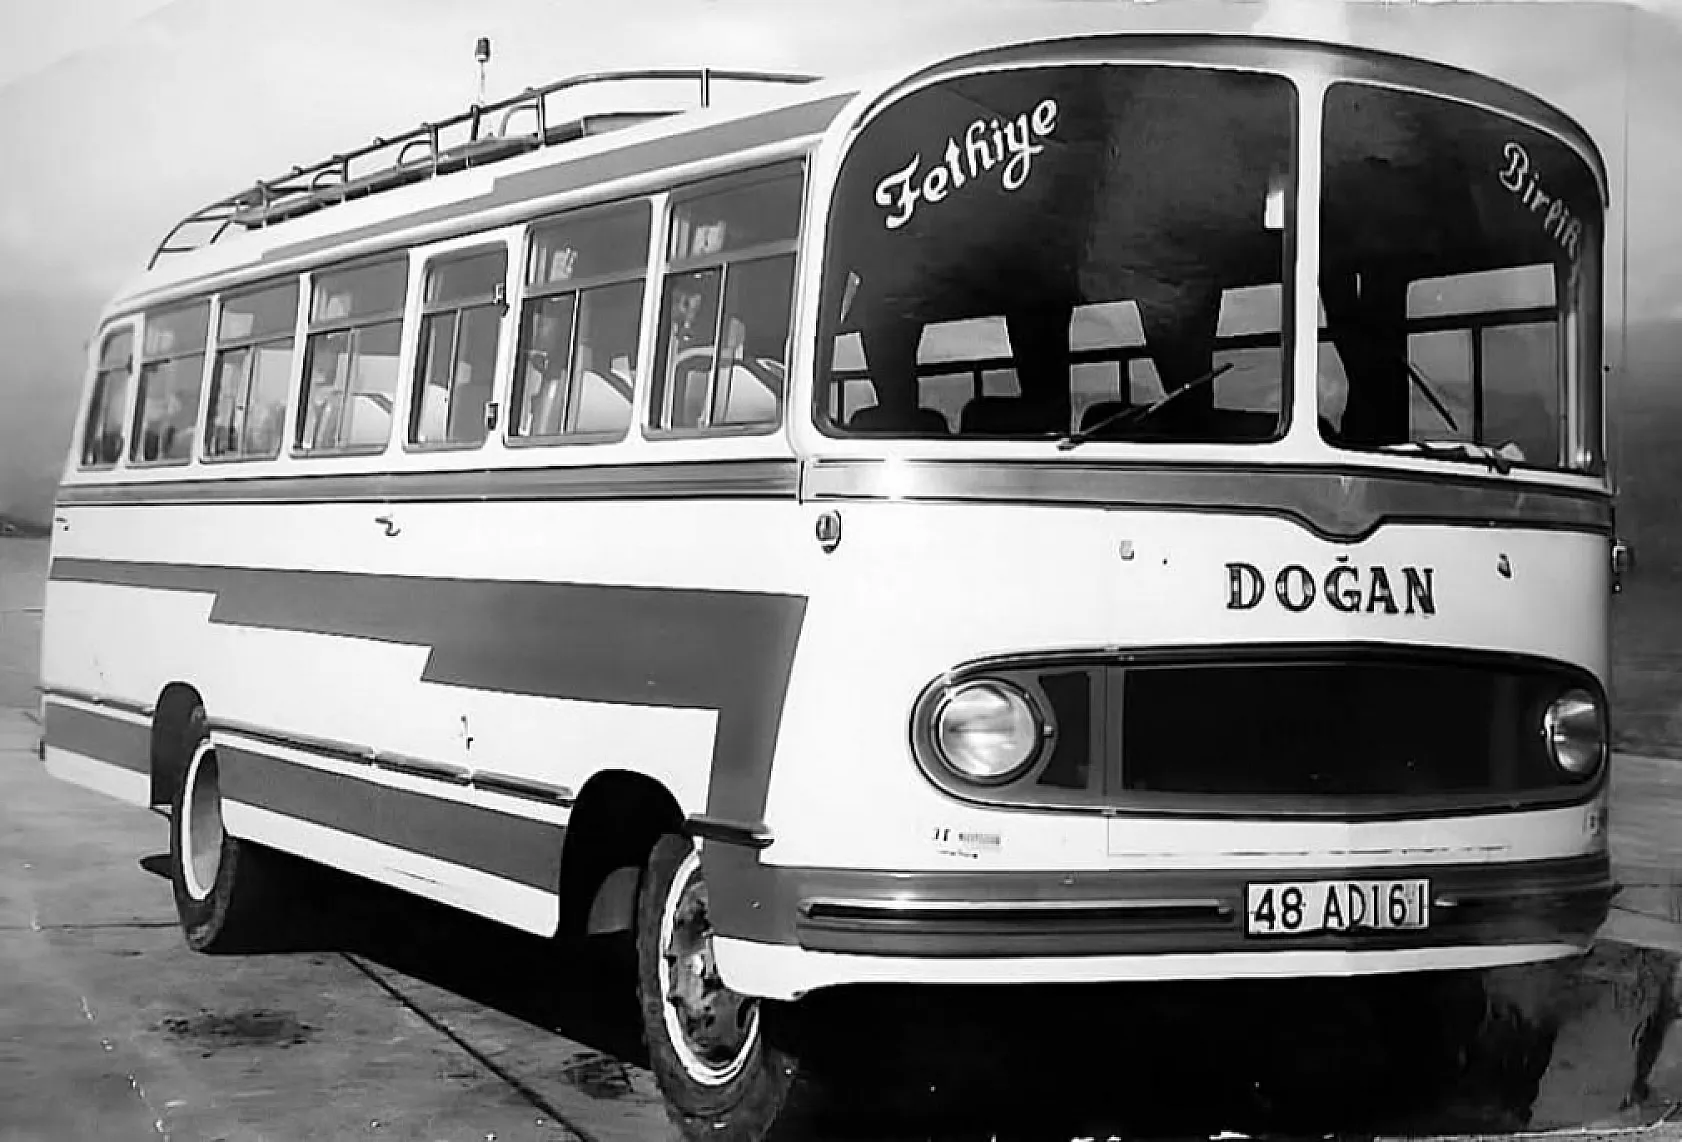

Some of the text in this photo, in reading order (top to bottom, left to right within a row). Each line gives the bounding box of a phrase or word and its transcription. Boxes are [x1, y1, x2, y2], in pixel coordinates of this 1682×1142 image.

[875, 98, 1058, 229] Fethiye
[1224, 555, 1436, 615] DOĞAN
[1254, 887, 1302, 930] 48
